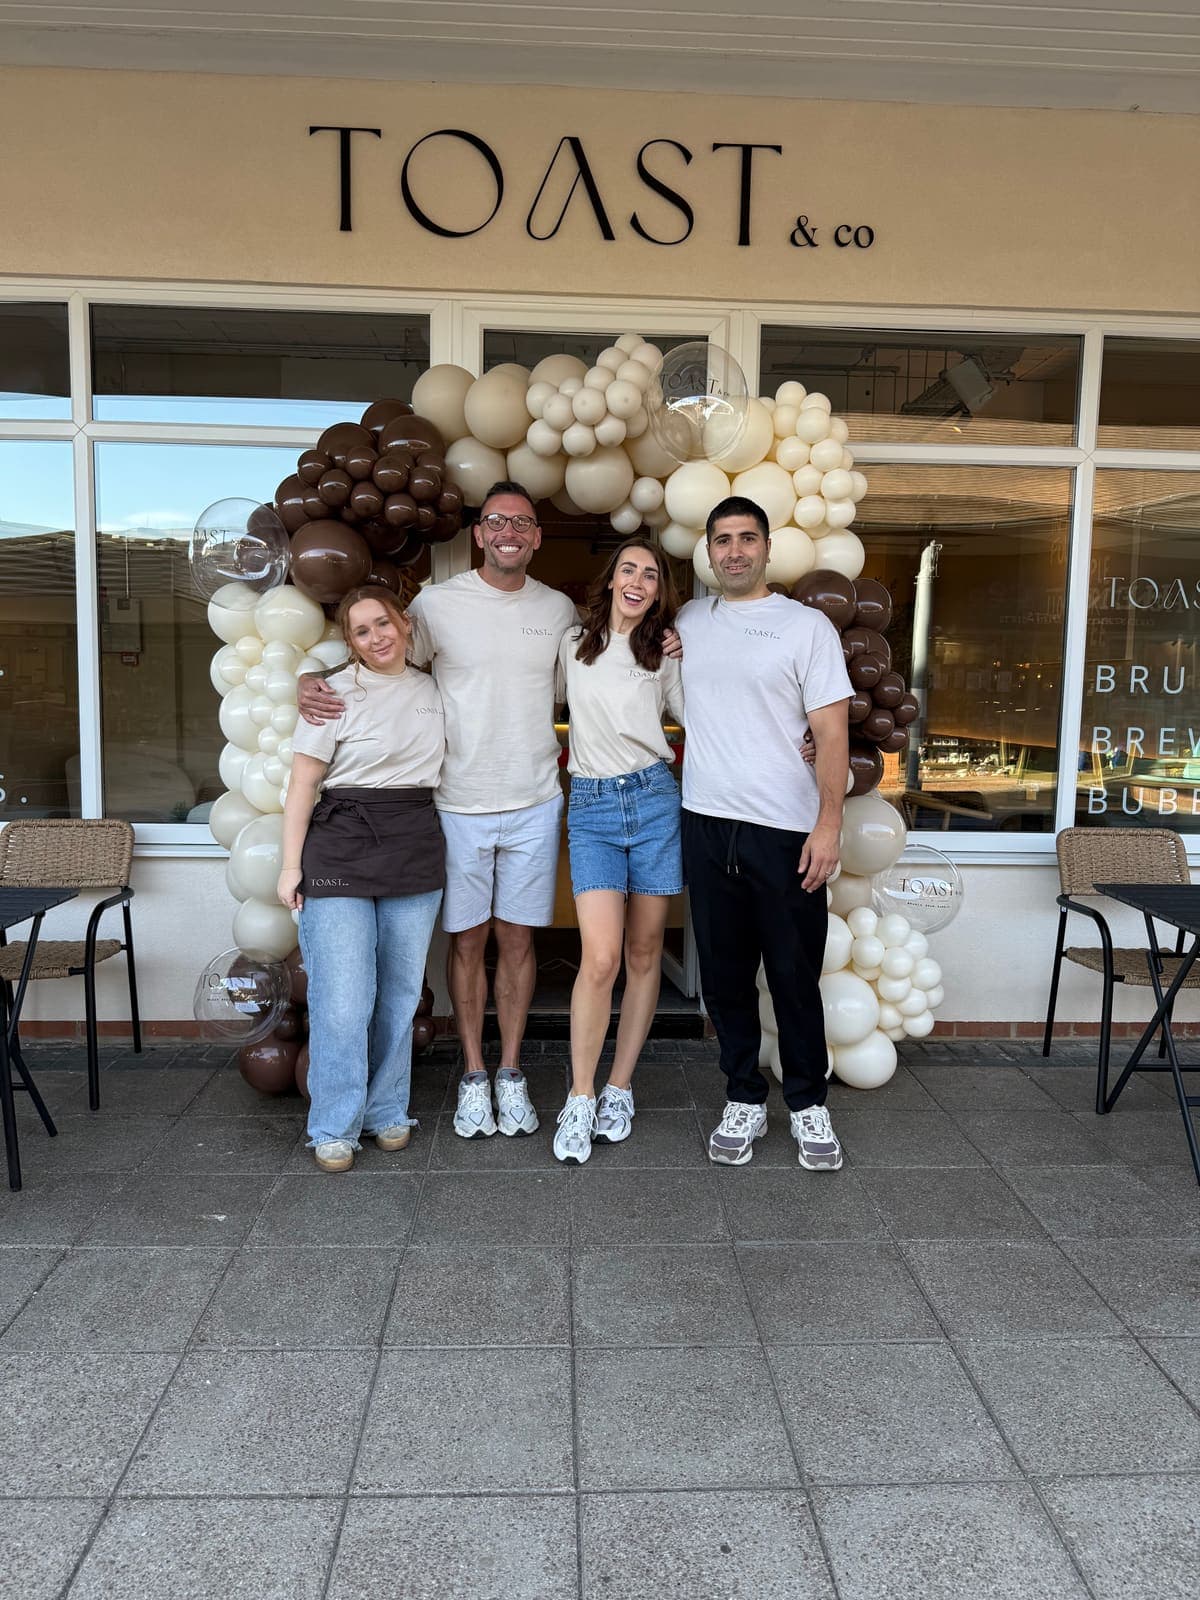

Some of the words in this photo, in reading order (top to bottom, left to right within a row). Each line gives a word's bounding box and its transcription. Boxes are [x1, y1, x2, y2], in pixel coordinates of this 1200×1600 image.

[309, 126, 782, 246] TOAST
[790, 215, 819, 247] &
[834, 224, 874, 248] co
[661, 373, 720, 394] TOAST
[311, 878, 342, 887] TOAST
[899, 878, 954, 897] TOAST
